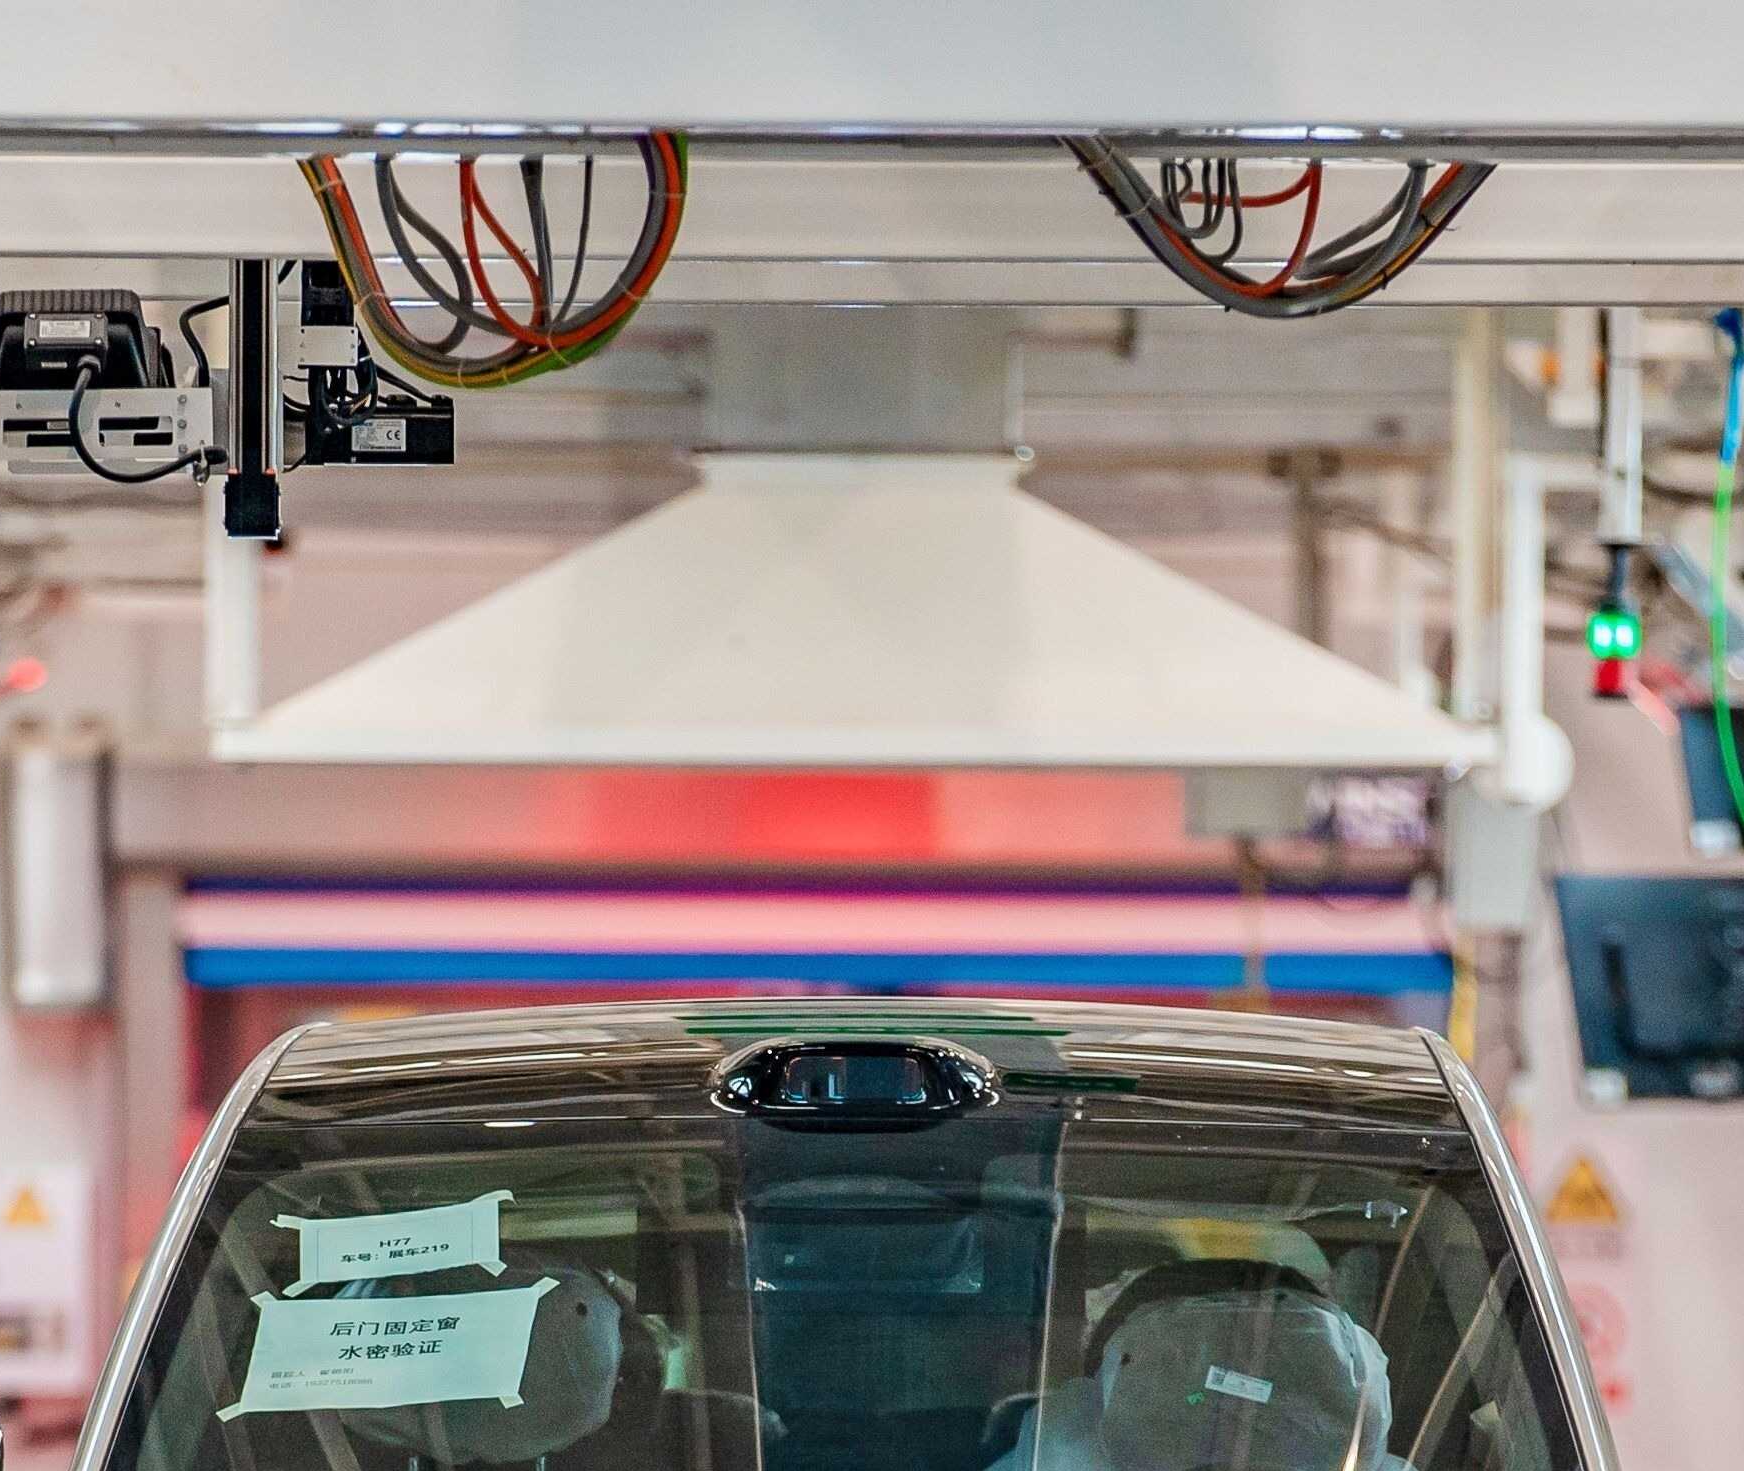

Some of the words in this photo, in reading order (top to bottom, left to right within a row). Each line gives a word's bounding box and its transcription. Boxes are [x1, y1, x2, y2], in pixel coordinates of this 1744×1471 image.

[379, 1236, 411, 1248] H77
[330, 1316, 461, 1336] 后门固定窗
[338, 1339, 444, 1360] 水密验证
